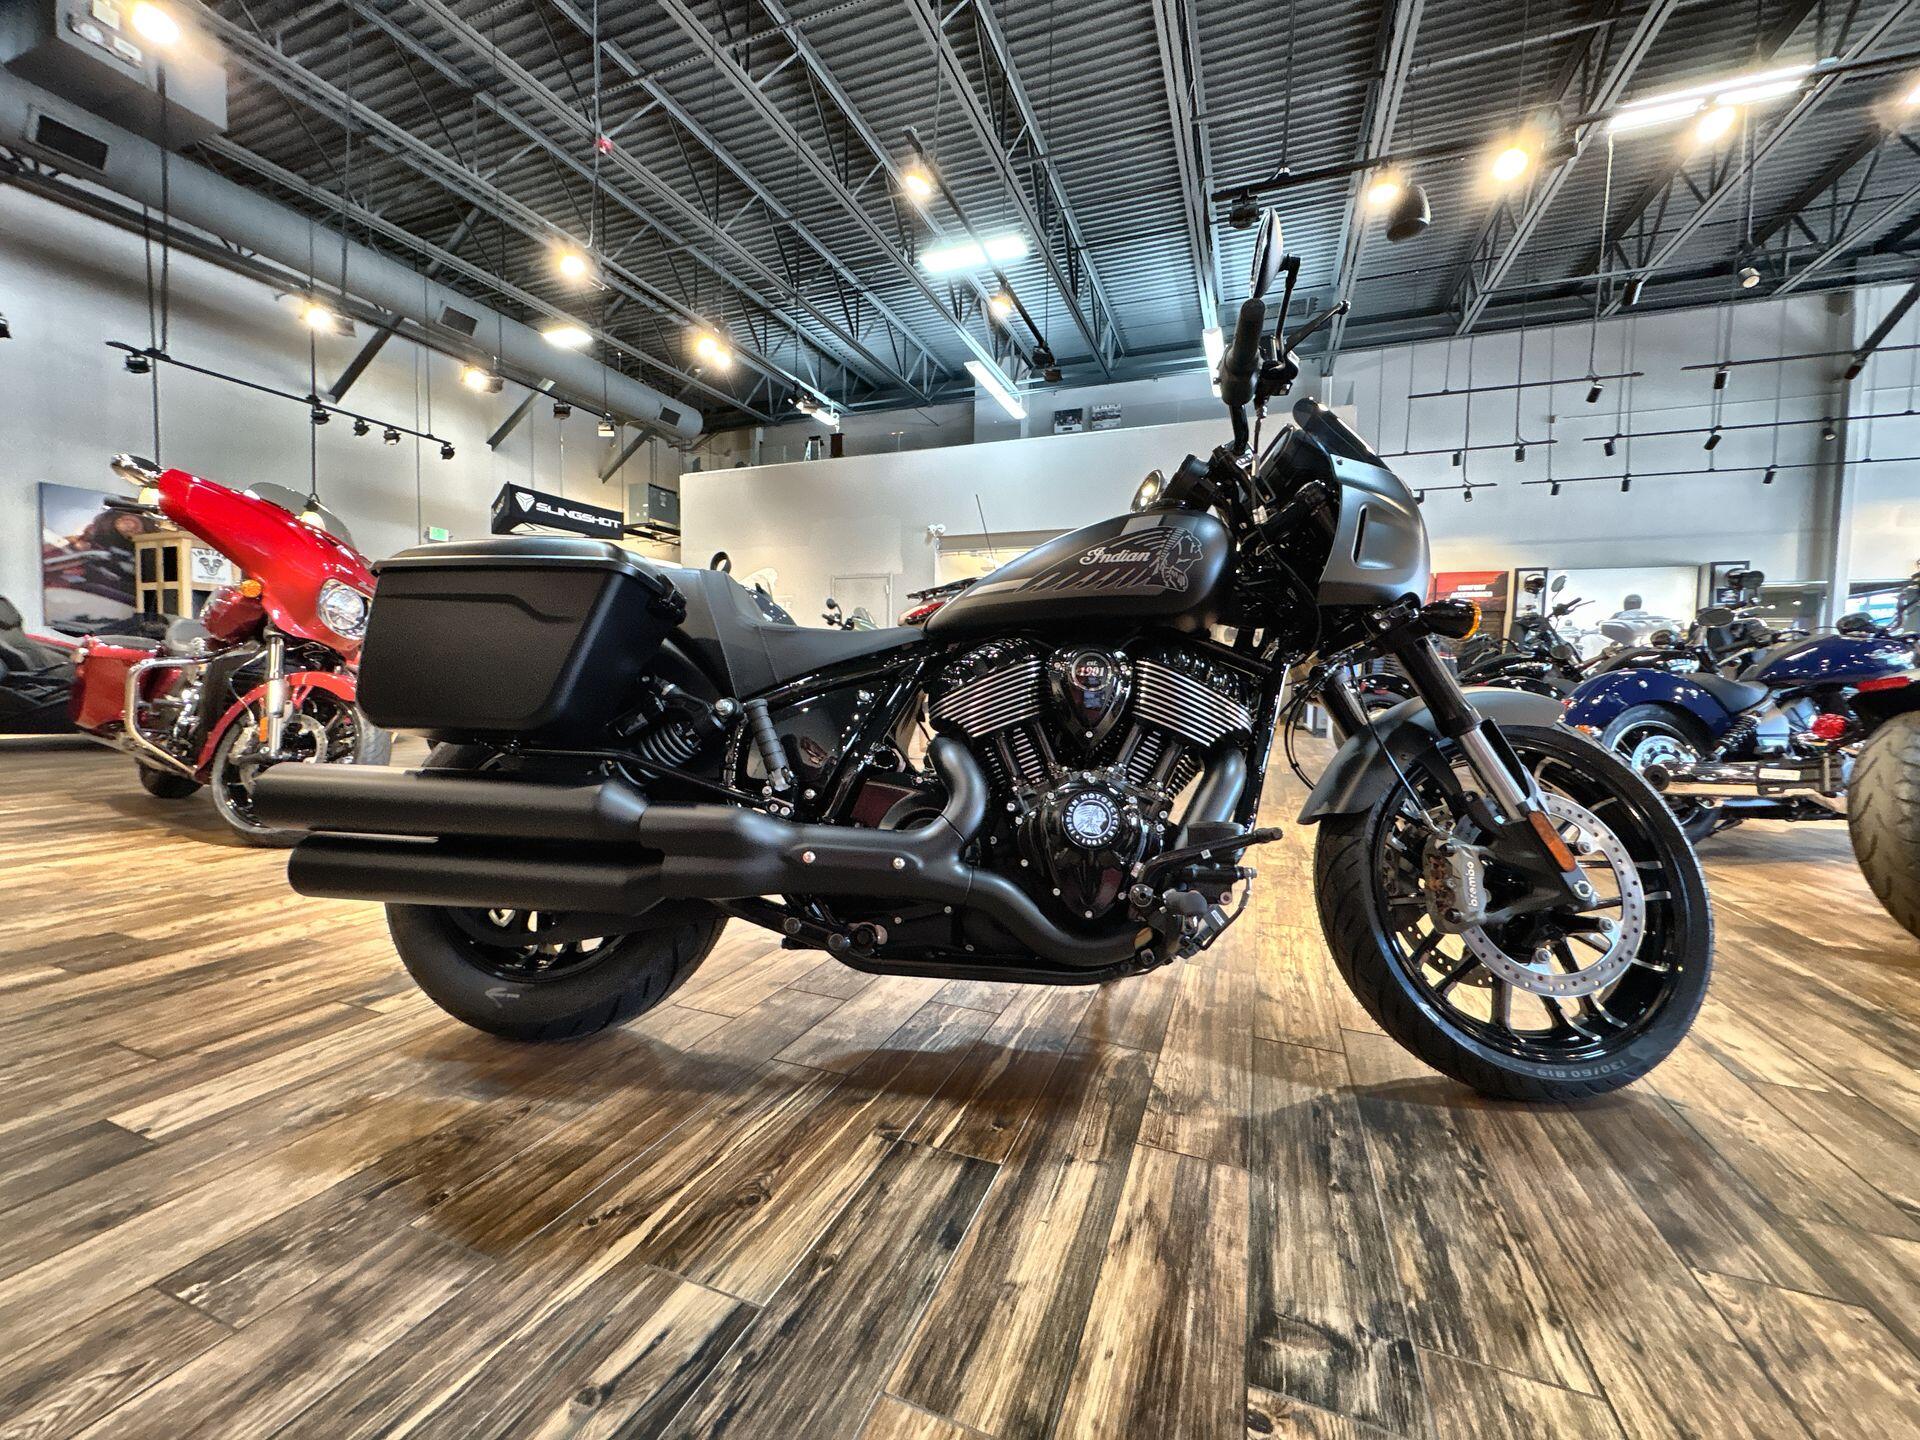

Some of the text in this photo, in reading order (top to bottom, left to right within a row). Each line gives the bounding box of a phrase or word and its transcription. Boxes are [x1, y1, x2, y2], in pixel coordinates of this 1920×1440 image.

[536, 502, 622, 529] SLINGSHOT
[1079, 547, 1151, 566] Indian
[1079, 666, 1105, 677] 1901
[1065, 793, 1119, 837] INDIAN MOTORCYCLE
[1081, 838, 1102, 846] 1901
[1465, 861, 1478, 907] brembo
